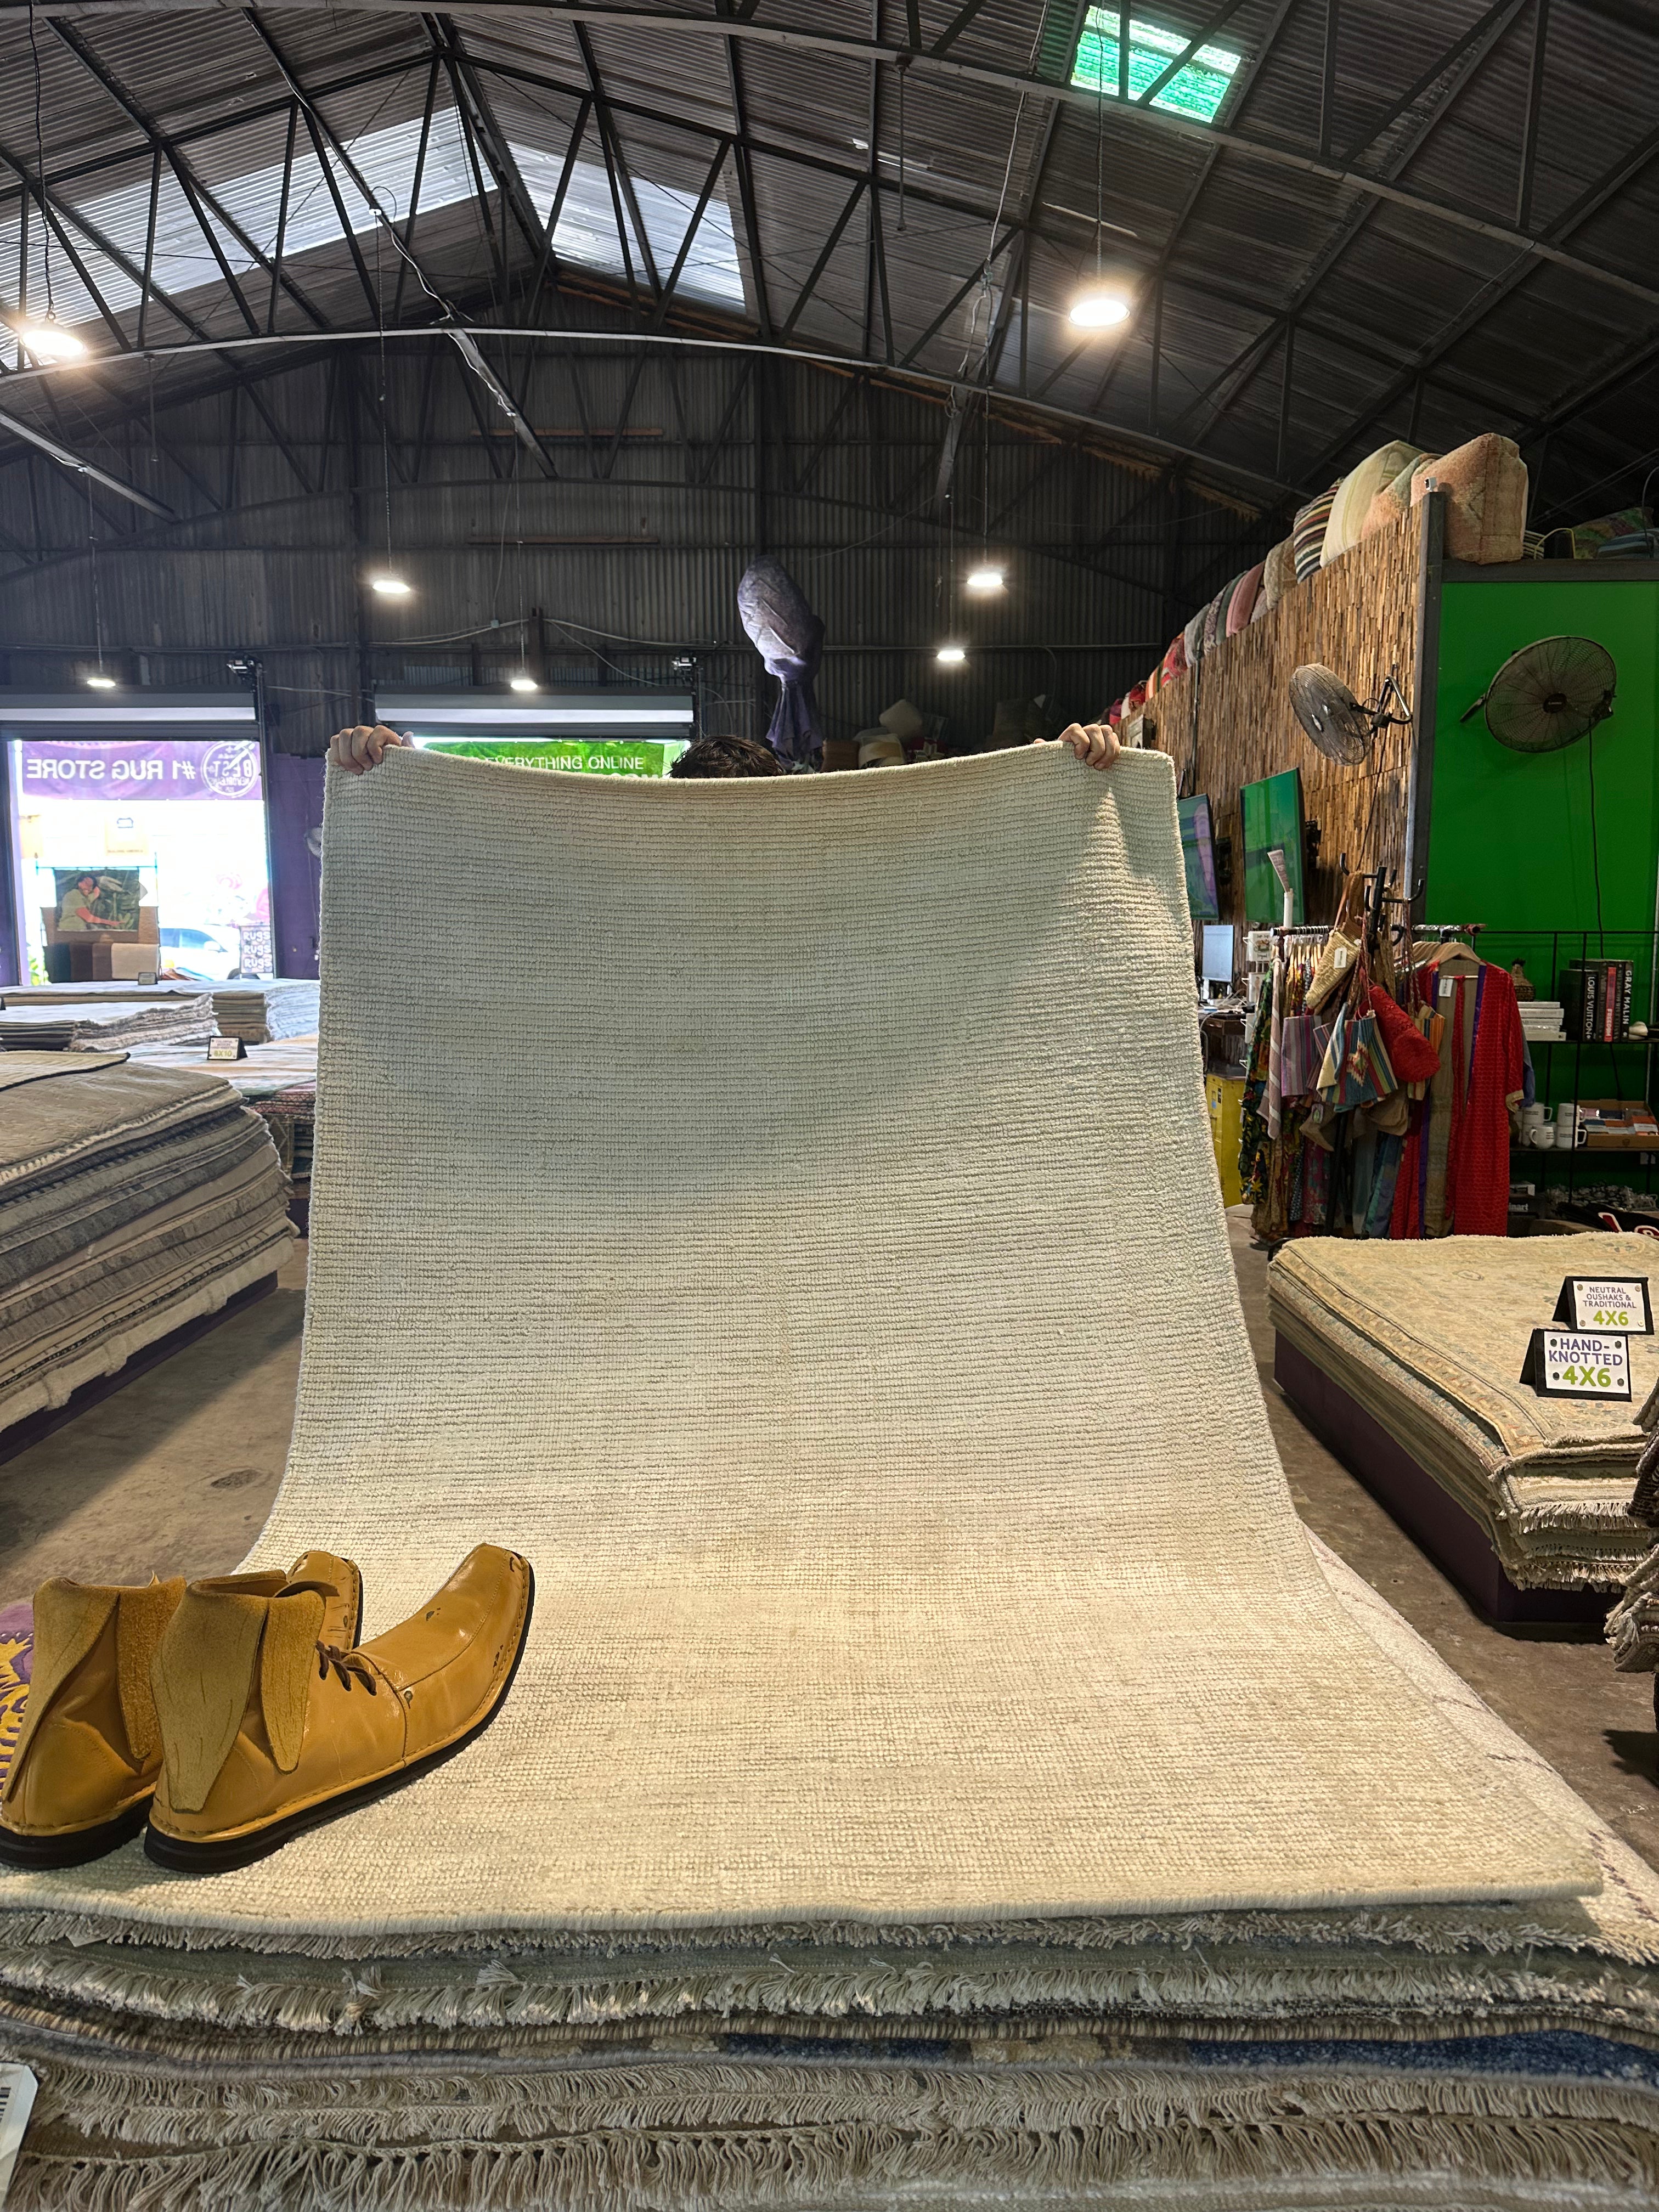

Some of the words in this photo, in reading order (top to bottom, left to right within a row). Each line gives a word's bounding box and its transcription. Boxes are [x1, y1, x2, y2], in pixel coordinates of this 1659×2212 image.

[588, 756, 644, 770] ONLINE
[1587, 976, 1595, 1000] LOUIS
[1585, 1000, 1594, 1035] VUITTON
[1622, 996, 1630, 1025] MALIN
[1583, 1300, 1637, 1308] TRADITIONAL
[1593, 1310, 1629, 1326] 4X6
[1560, 1338, 1610, 1352] HAND-
[1549, 1350, 1623, 1366] KNOTTED
[1562, 1365, 1611, 1387] 4X6
